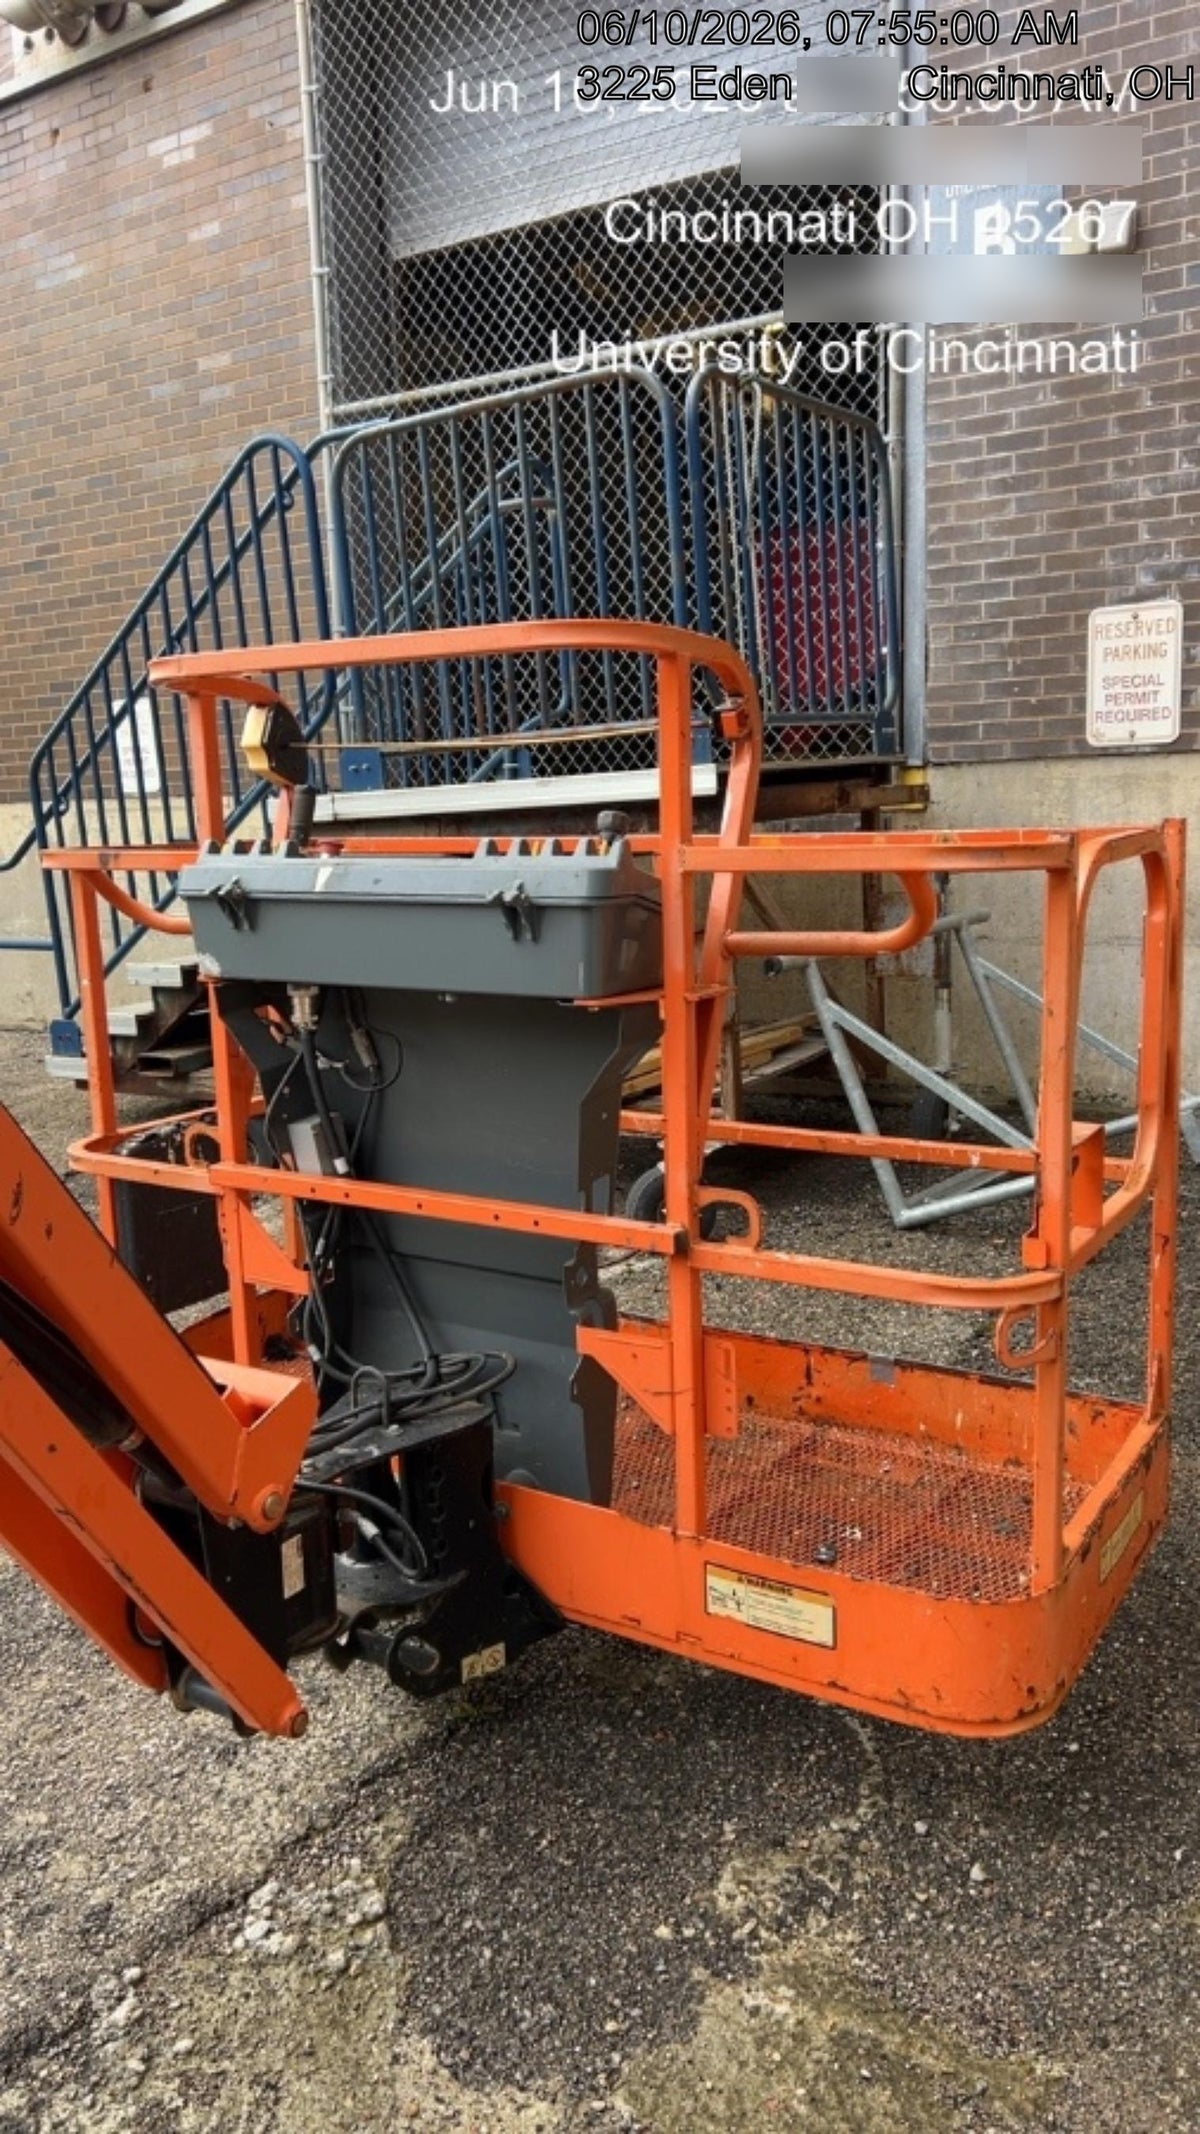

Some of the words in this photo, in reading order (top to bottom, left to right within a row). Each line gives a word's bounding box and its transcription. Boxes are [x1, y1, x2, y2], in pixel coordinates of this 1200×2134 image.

[1095, 616, 1178, 641] RESERVED
[1104, 641, 1168, 662] PARKING
[1102, 673, 1165, 690] SPECIAL
[1105, 689, 1161, 707] PERMIT
[1095, 706, 1172, 724] REQUIRED
